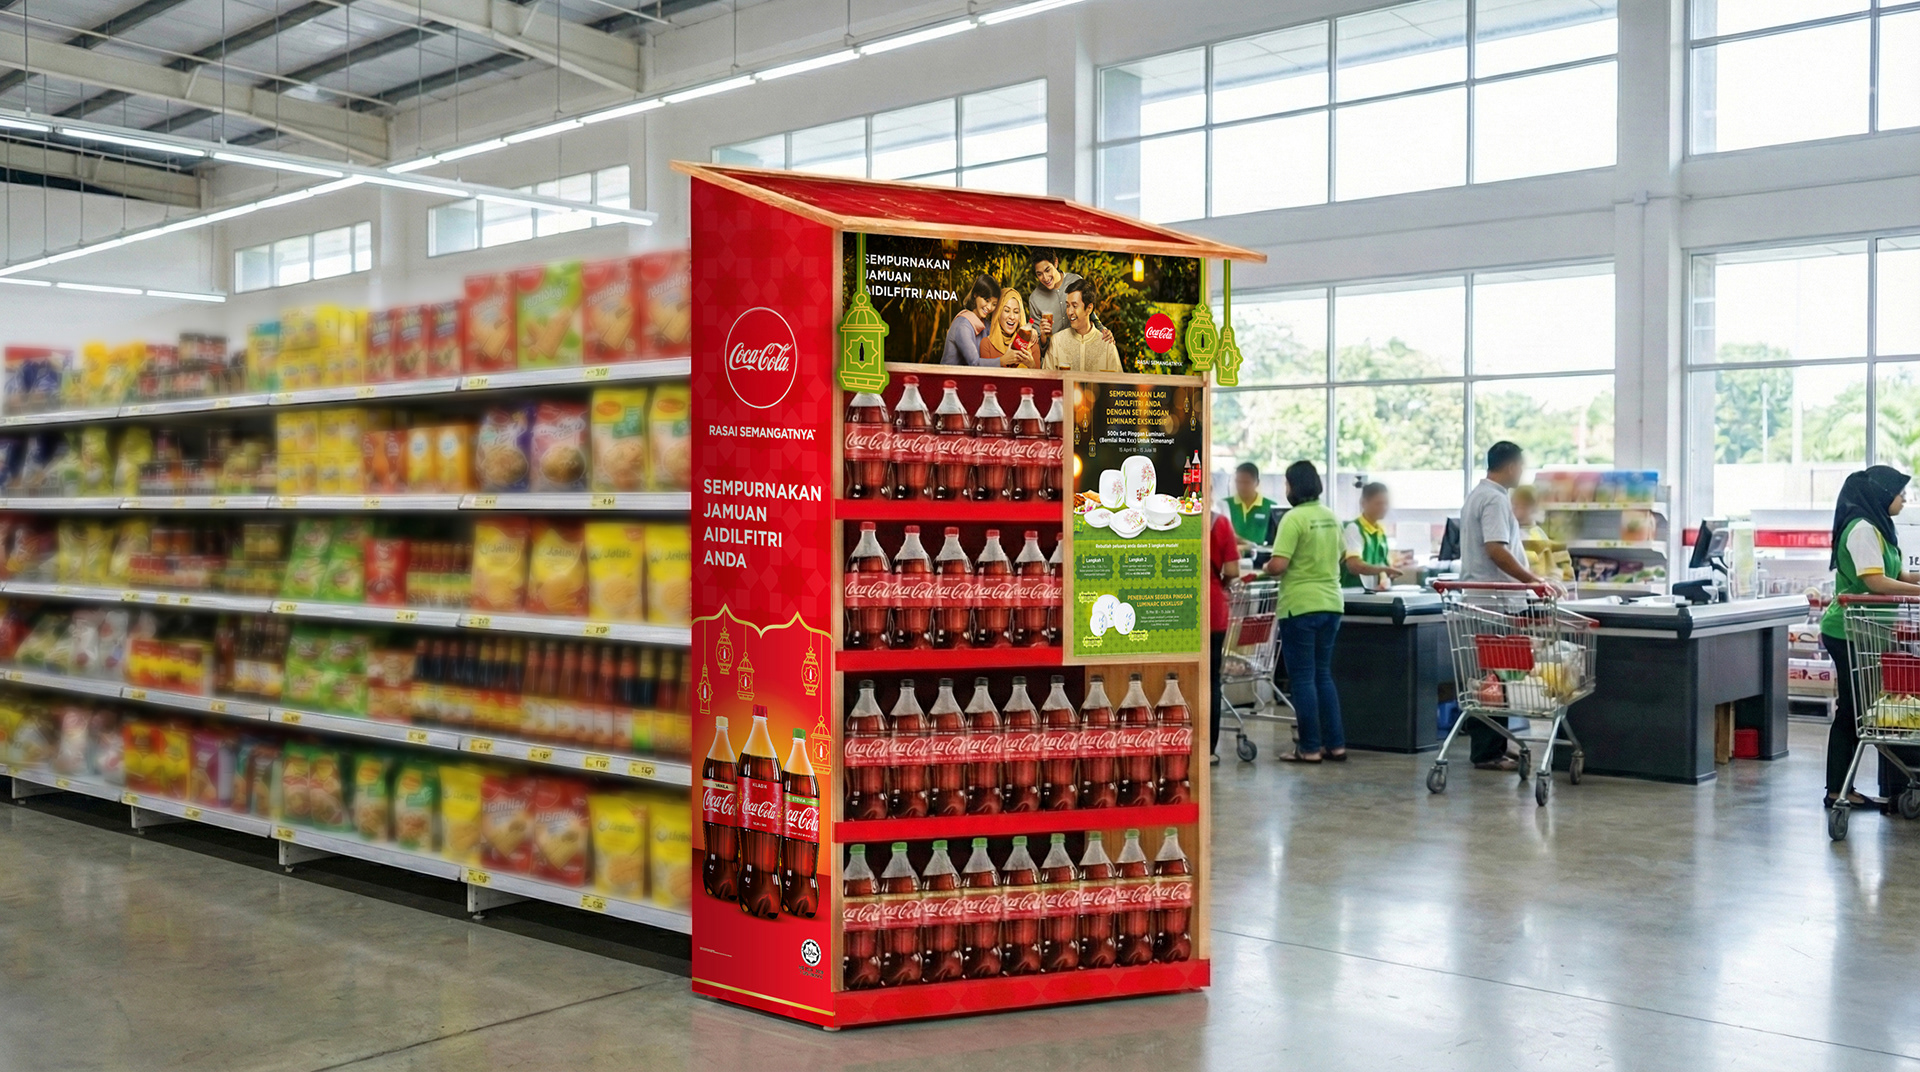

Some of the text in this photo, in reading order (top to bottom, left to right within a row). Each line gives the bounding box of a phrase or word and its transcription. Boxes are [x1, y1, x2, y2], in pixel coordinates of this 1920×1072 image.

[865, 254, 950, 270] SEMPURNAKAN
[865, 270, 911, 282] JAMUAN
[925, 289, 958, 301] ANDA
[1146, 326, 1174, 339] Coca-Cola
[729, 342, 793, 372] Coca-Cola
[709, 425, 738, 436] RASAI
[703, 478, 821, 501] SEMPURNAKAN
[703, 502, 766, 522] JAMUAN
[703, 526, 782, 547] AIDILFITRI
[703, 550, 747, 568] ANDA
[742, 798, 776, 819] Coca-Cola
[786, 807, 819, 832] ca-Cola
